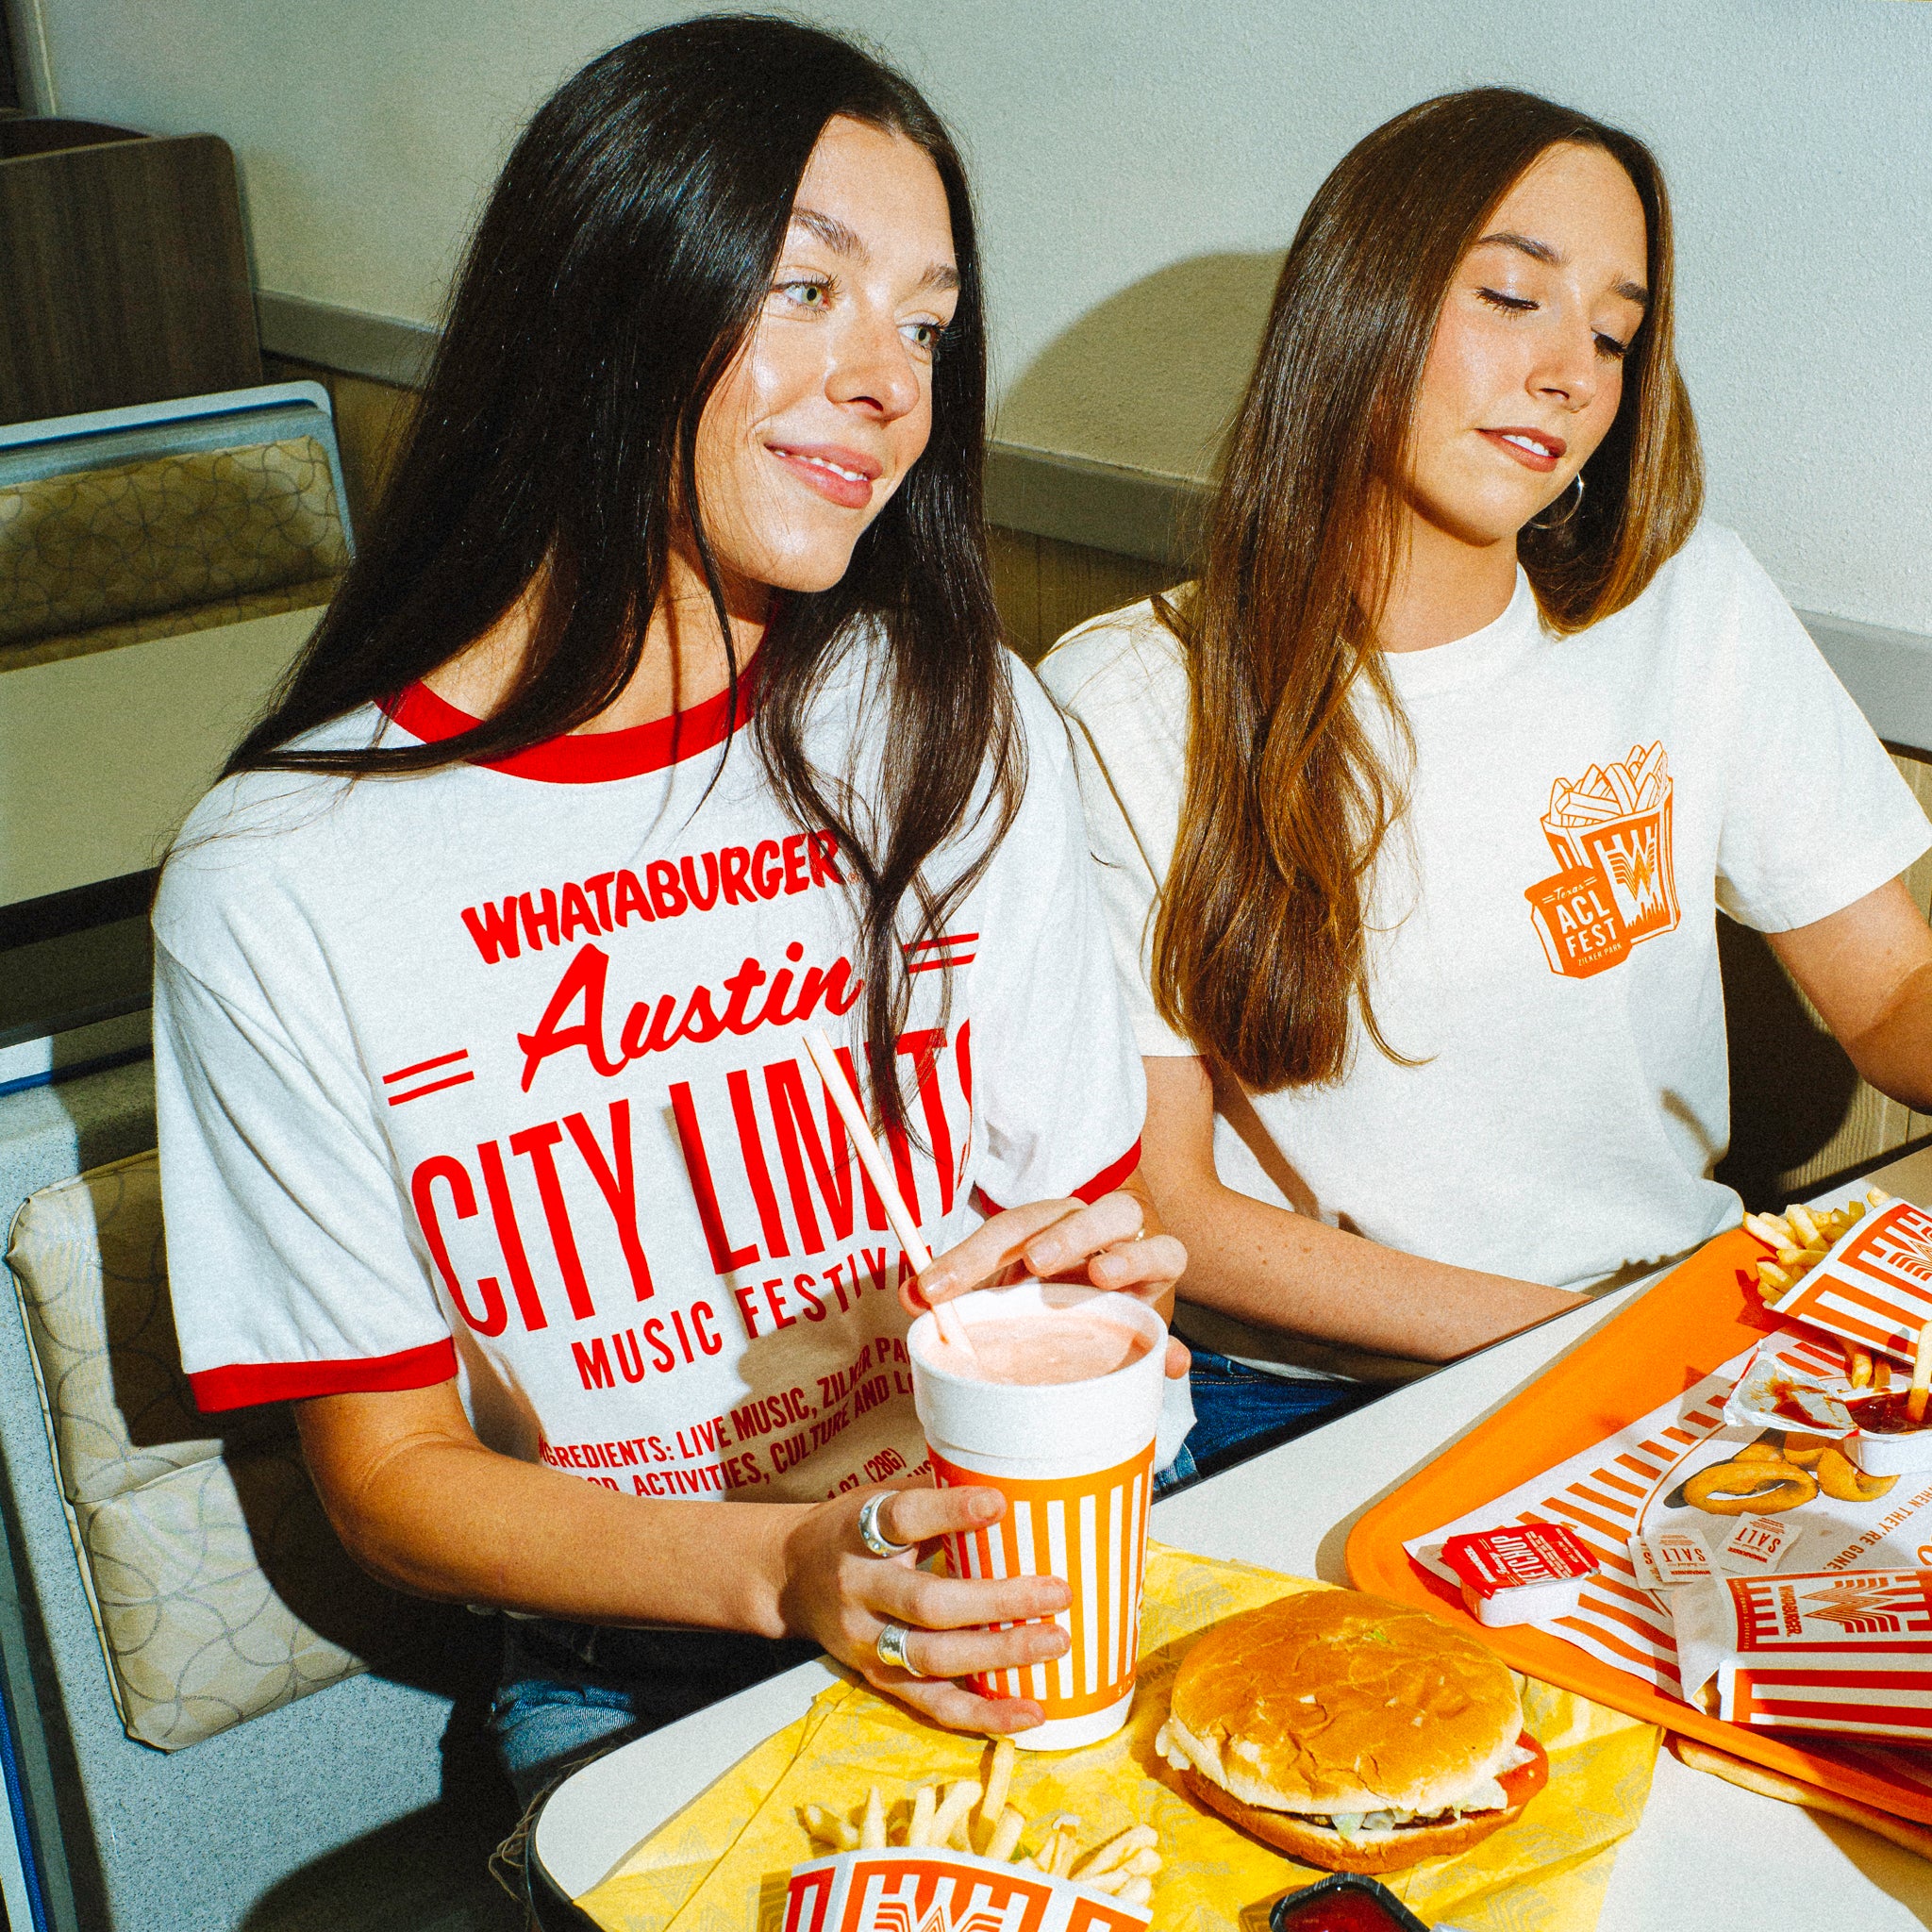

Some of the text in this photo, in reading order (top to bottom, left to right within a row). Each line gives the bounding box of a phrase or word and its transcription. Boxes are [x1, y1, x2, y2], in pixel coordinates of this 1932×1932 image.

[460, 828, 846, 964] WHATABURGER
[1554, 884, 1584, 900] Texas
[1556, 890, 1610, 935] ACL
[1566, 918, 1616, 958] FEST
[1604, 943, 1623, 956] PARK
[517, 941, 865, 1093] Austin
[411, 1099, 655, 1338] CITY
[571, 1245, 933, 1391] MUSIC FESTIVA
[538, 1432, 675, 1469] NGREDIENTS:
[675, 1416, 732, 1459] LIVE
[730, 1388, 818, 1442] MUSIC,
[816, 1345, 873, 1409] ZILKER
[632, 1452, 770, 1497] ACTIVITIES,
[769, 1402, 850, 1475] CULTURE
[854, 1374, 891, 1419] AND
[863, 1447, 908, 1483] (28G)
[1735, 1527, 1782, 1554] SALT
[1823, 1486, 1932, 1571] HEN THEY'RE GONE.
[1490, 1535, 1557, 1584] KETCHUP
[1661, 1547, 1706, 1562] SALT
